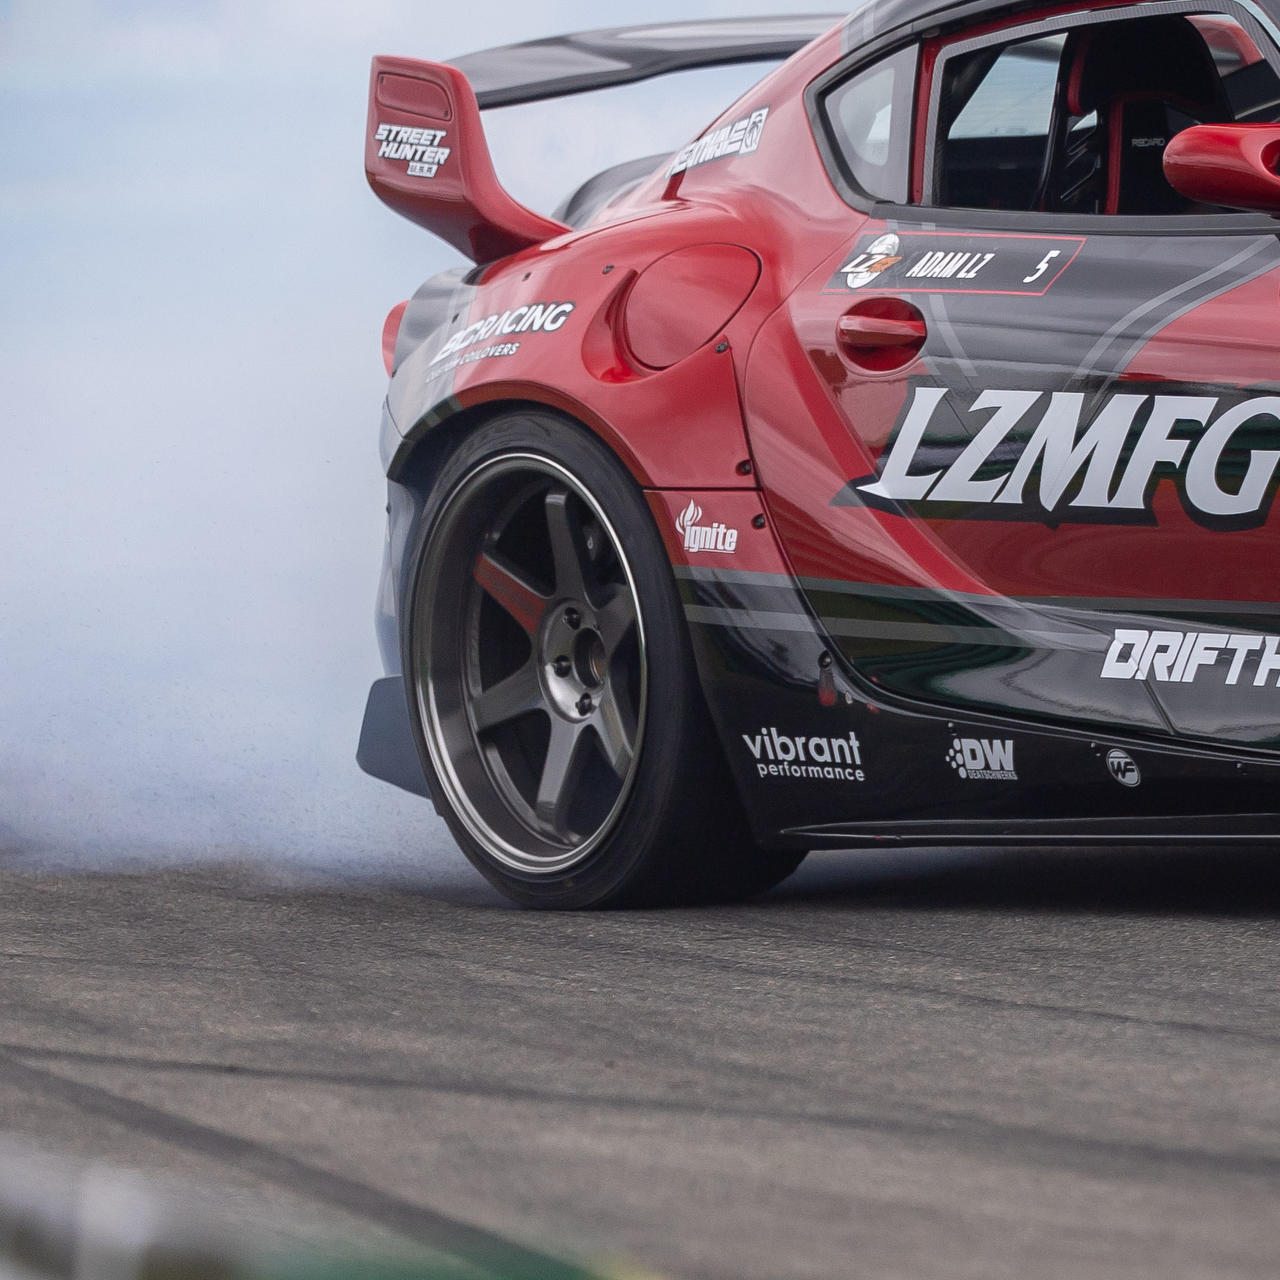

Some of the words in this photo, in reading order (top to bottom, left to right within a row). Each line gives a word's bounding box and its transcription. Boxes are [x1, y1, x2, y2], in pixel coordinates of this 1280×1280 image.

[375, 123, 447, 147] STREET
[378, 141, 451, 165] HUNTER
[905, 251, 971, 278] ADAM
[956, 252, 996, 279] LZ
[1022, 250, 1061, 283] 5
[683, 521, 739, 553] ignite
[742, 727, 862, 766] vibrant
[961, 738, 1014, 772] DW
[756, 761, 866, 782] performance
